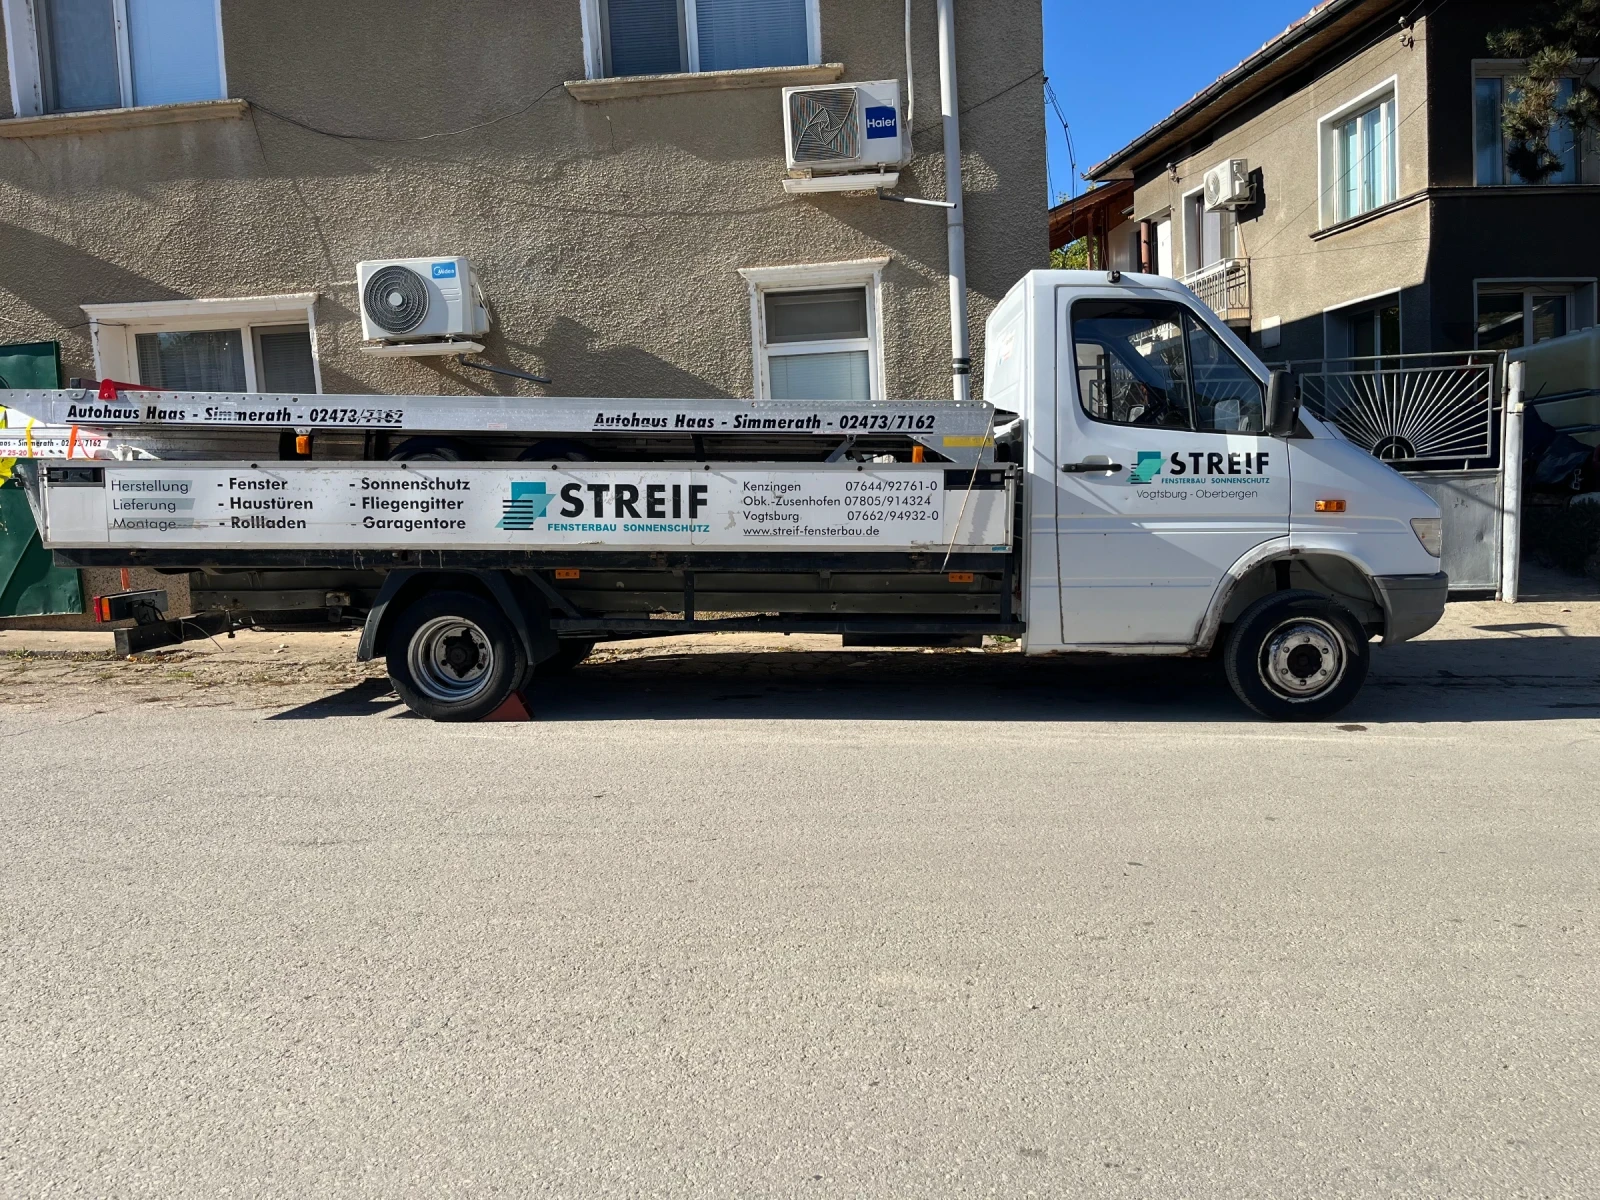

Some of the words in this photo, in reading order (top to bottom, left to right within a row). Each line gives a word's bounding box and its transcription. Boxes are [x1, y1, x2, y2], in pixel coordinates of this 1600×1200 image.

[867, 117, 895, 128] Haier
[67, 405, 139, 419] Autohaus
[146, 406, 185, 421] Haas
[204, 407, 292, 423] Simmerath
[594, 412, 667, 428] Autohaus
[674, 414, 714, 429] Haas
[733, 414, 820, 430] Simmerath
[839, 415, 935, 430] 02473/7162
[1170, 451, 1269, 475] STREIF
[111, 480, 189, 494] Herstellung
[229, 478, 288, 490] Fenster
[361, 477, 471, 491] Sonnenschutz
[743, 481, 801, 493] Kenzingen
[845, 481, 938, 492] 07644/92761-0
[559, 483, 708, 519] STREIF
[1137, 490, 1187, 500] Vogtsburg
[1196, 489, 1258, 500] Oberbergen
[113, 499, 176, 513] Lieferung
[230, 497, 314, 510] Haustüren
[362, 497, 464, 513] Fliegengitter
[743, 496, 841, 507] Obk.-Zusenhofen
[844, 496, 931, 507] 07805/914324
[231, 516, 307, 529] Rollladen
[743, 511, 800, 523] Vogtsburg
[847, 511, 939, 522] 07662/94932-0
[113, 518, 177, 531] Montage
[362, 516, 466, 532] Garagentore
[548, 523, 617, 532] FENSTERBAU
[623, 524, 710, 533] SONNENSCHUTZ
[743, 526, 880, 537] www.streif-fensterbau.de
